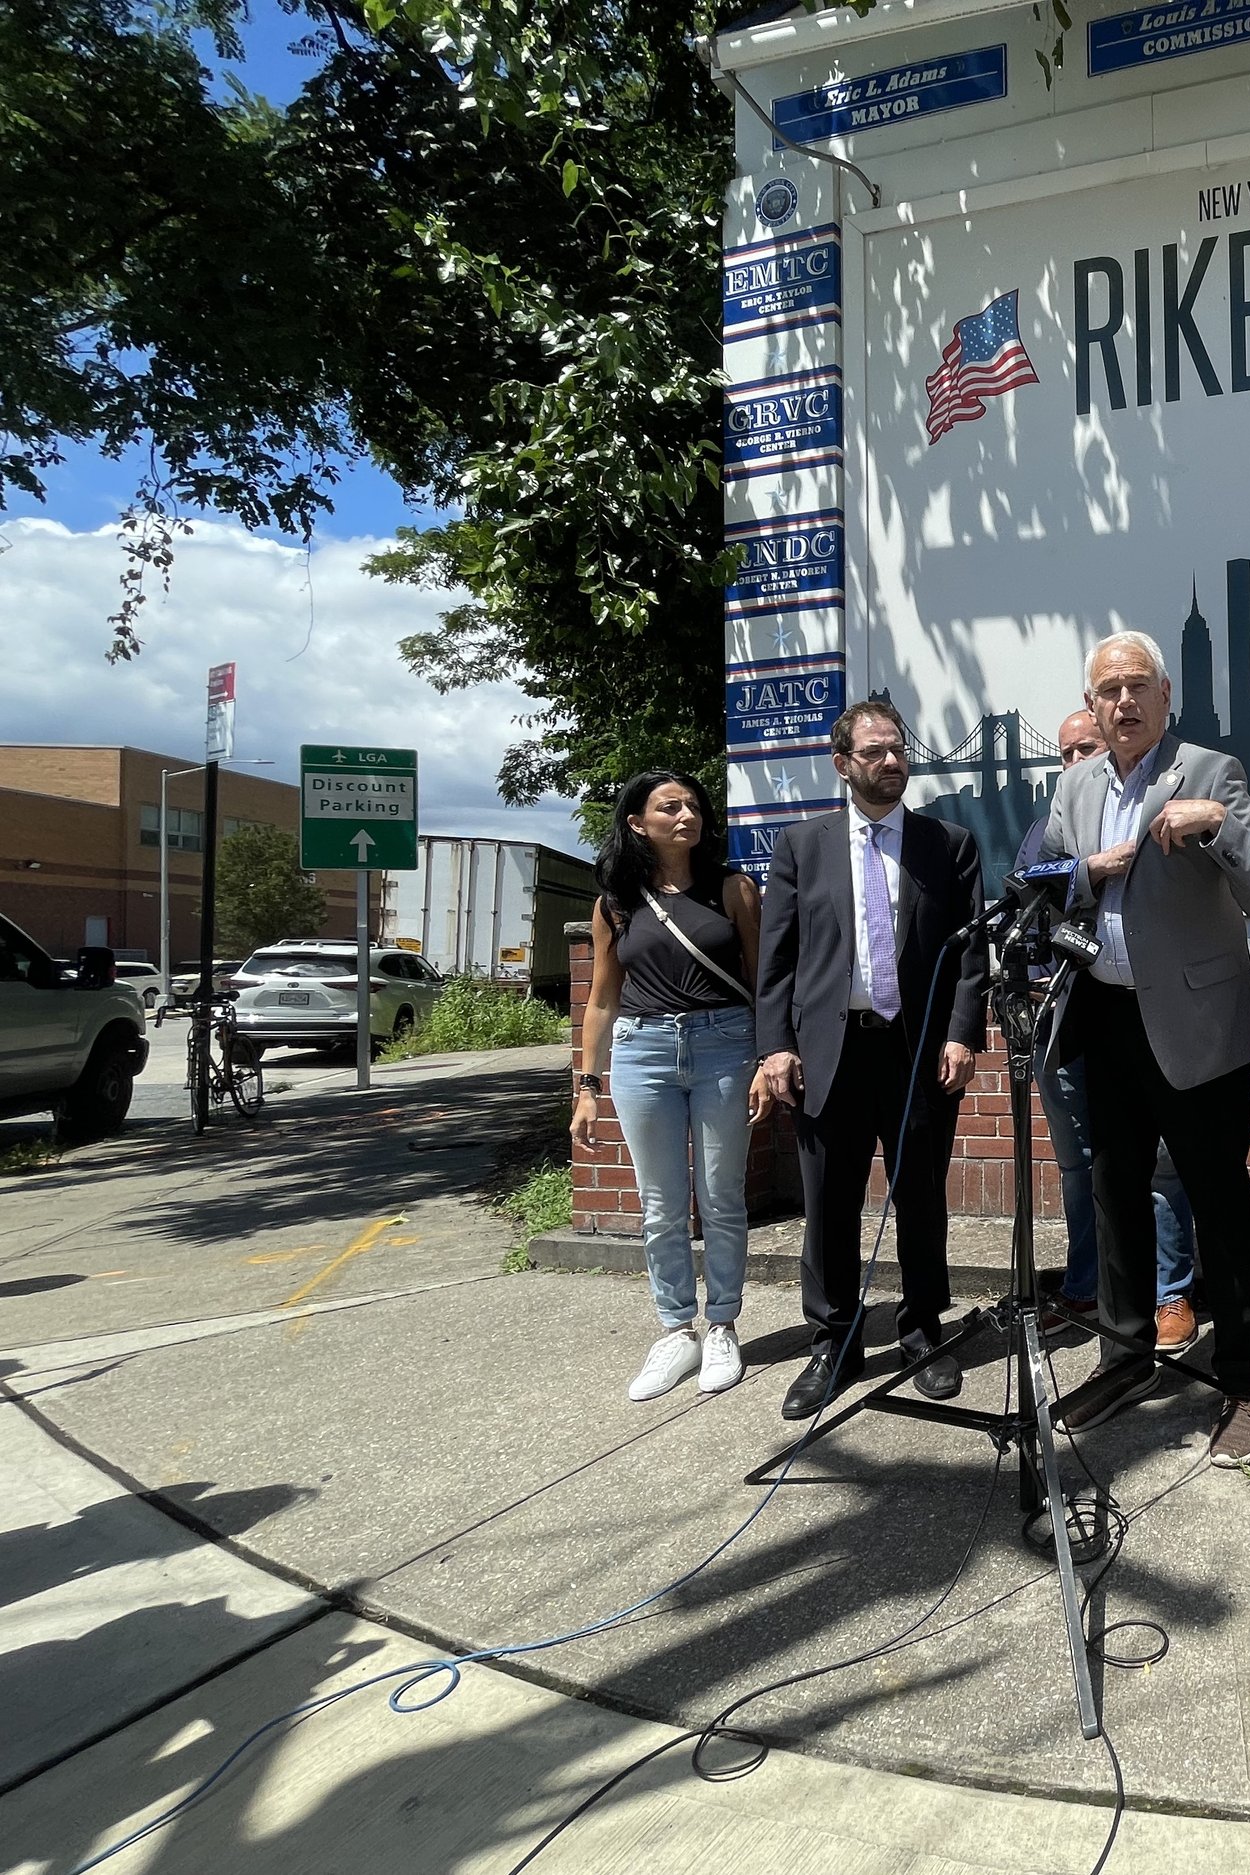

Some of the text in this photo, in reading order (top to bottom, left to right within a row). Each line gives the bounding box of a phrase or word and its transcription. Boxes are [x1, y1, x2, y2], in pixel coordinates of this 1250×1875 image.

[1139, 5, 1196, 31] Louis
[825, 66, 947, 107] Eric L. Adams
[852, 96, 919, 125] MAYOR
[1199, 186, 1241, 222] NEW
[725, 248, 829, 297] EMTC
[741, 285, 813, 309] ERIC M. TAYLOR
[758, 299, 795, 314] CENTER
[728, 388, 829, 432] GRVC
[736, 425, 821, 448] GEORGE R. VIERNO
[760, 440, 796, 453] CENTER
[738, 531, 836, 569] NDC
[771, 571, 780, 581] N.
[782, 565, 827, 580] DAVOREN
[761, 580, 798, 592] CENTER
[735, 677, 830, 713] JATC
[742, 713, 823, 729] JAMES A. THOMAS
[763, 725, 800, 737] CENTER
[358, 752, 387, 763] LGA
[312, 779, 406, 793] Discount
[320, 799, 399, 816] Parking
[1028, 862, 1061, 873] PIX
[1061, 927, 1089, 943] SPECTRUM
[1064, 934, 1087, 949] NEWS
